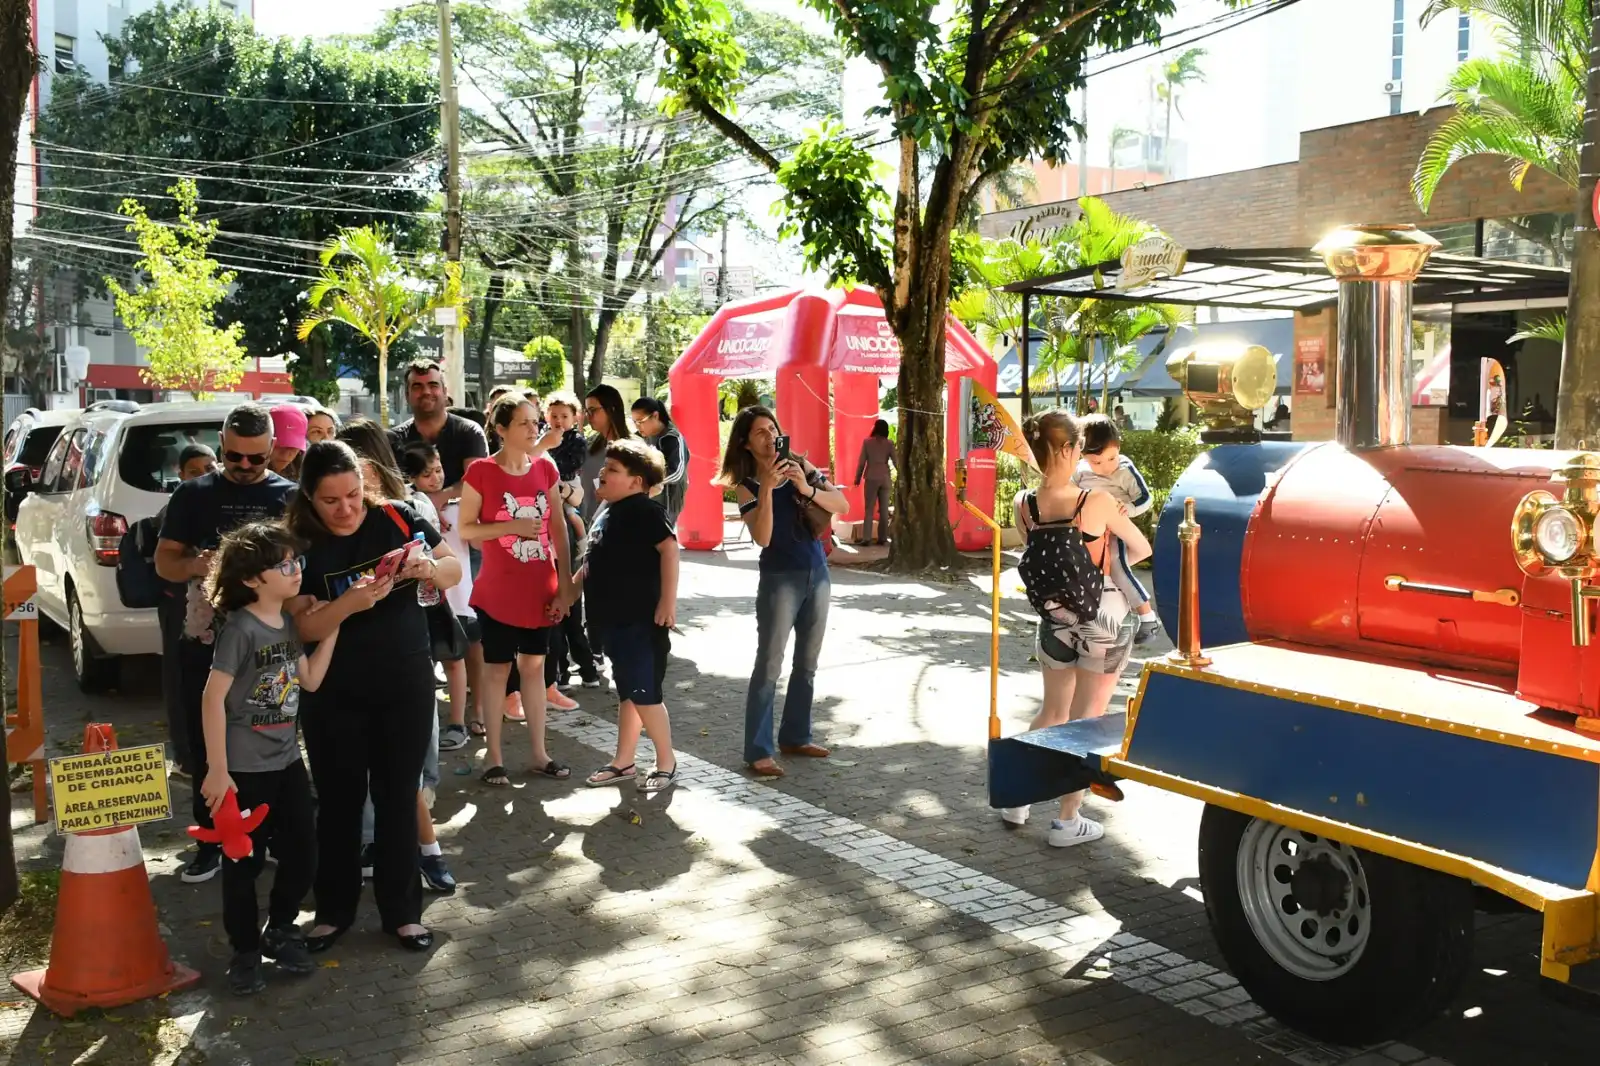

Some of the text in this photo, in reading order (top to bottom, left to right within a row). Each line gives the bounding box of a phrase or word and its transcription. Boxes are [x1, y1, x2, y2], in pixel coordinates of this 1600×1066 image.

[845, 335, 900, 352] UNIODO
[63, 751, 154, 771] EMBARQUE E
[56, 761, 163, 783] DESEMBARQUE
[68, 774, 154, 792] DE CRIANÇA
[98, 791, 162, 808] RESERVADA
[61, 805, 168, 829] PARA O TRENZINHO
